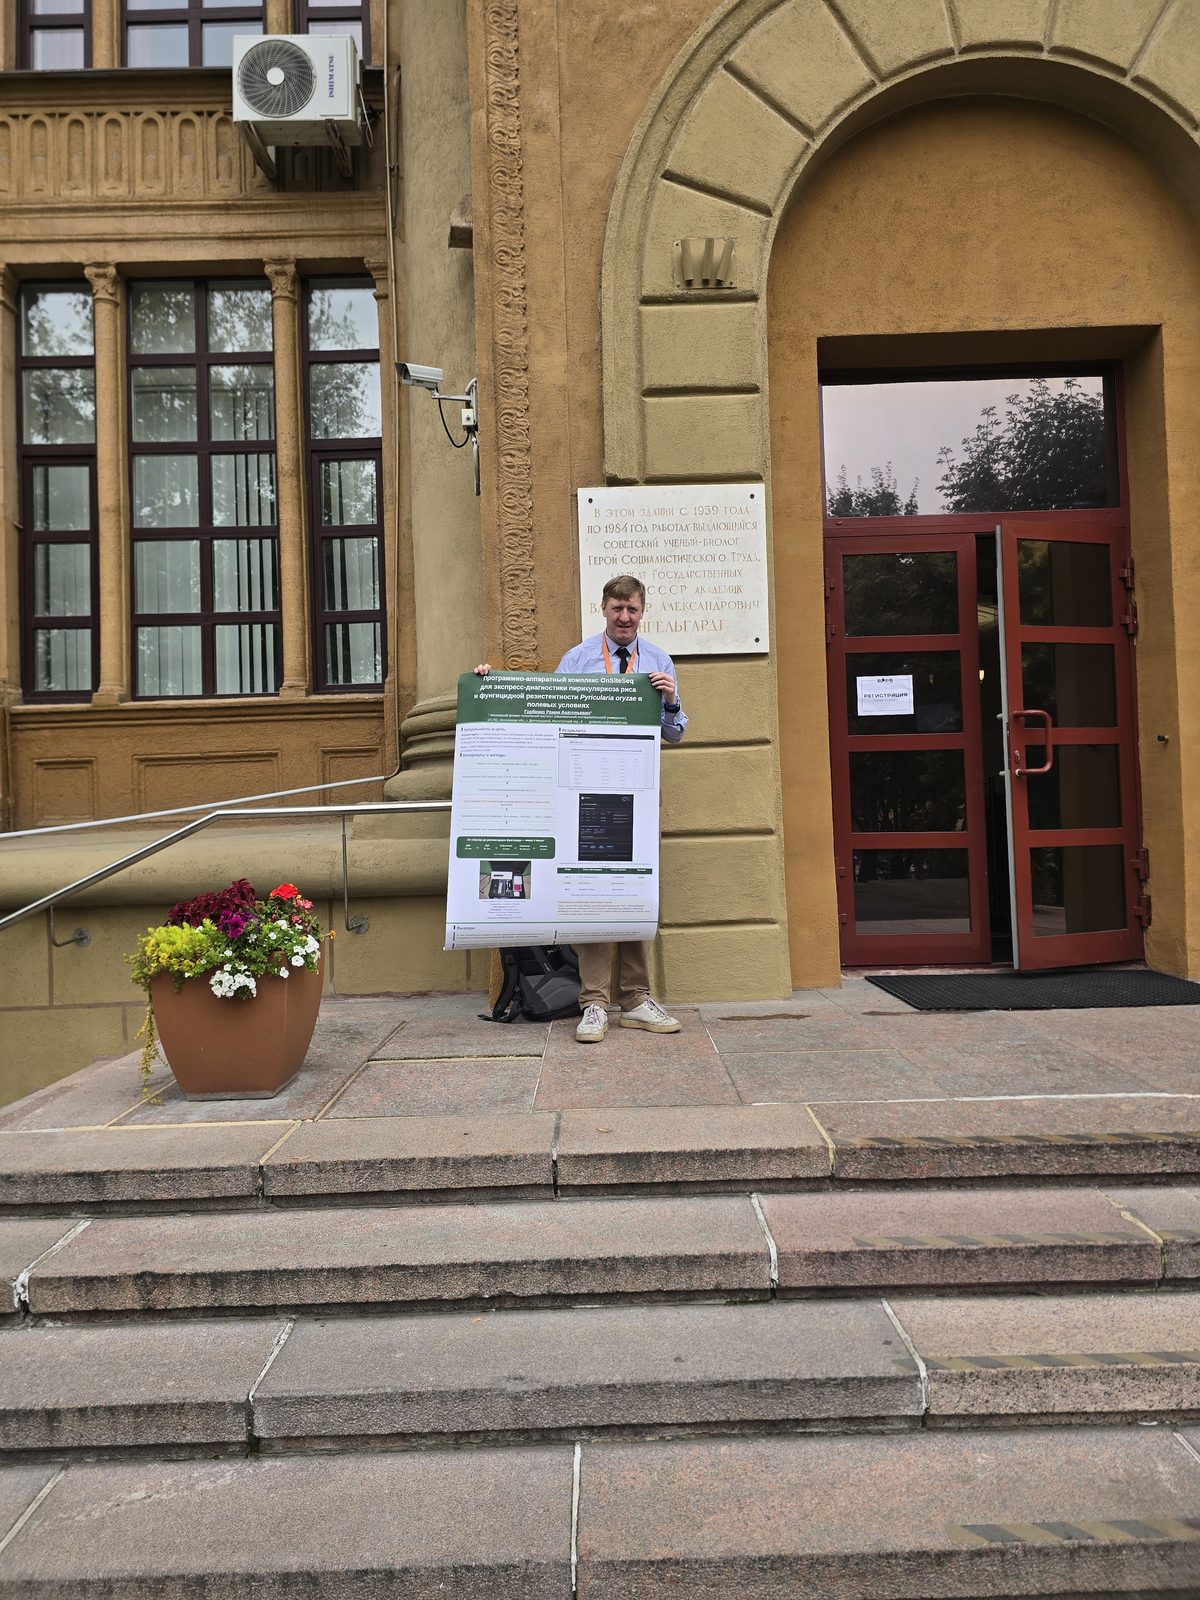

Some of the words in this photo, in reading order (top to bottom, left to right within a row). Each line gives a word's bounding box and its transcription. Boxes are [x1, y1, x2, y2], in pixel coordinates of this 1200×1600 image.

[594, 508, 601, 518] В
[605, 508, 635, 518] ЭТОМ
[641, 507, 674, 517] ЗДАНИИ
[679, 507, 687, 516] С
[694, 505, 719, 516] 1959
[724, 506, 750, 515] ГОДА
[587, 525, 601, 534] ПО
[605, 522, 628, 534] 1984
[630, 523, 648, 533] ГОД
[652, 523, 689, 533] РАБОТАЛ
[693, 520, 758, 532] ВЫДАЮЩИЙСЯ
[603, 537, 659, 549] СОВЕТСКИЙ
[663, 537, 741, 548] УЧЕНЫЙ-БИОЛОГ
[588, 554, 617, 565] ГЕРОЙ
[621, 553, 726, 565] СОЦИАЛИСТИЧЕСКОГО
[652, 569, 744, 579] ГОСУДАРСТВЕННЫХ
[647, 584, 687, 595] СССР
[694, 584, 743, 595] АКАДЕМИК
[661, 600, 760, 612] АЛЕКСАНДРОВИЧ
[639, 619, 725, 633] НГЕЛЬГАРДТ
[600, 677, 634, 685] OnSiteSeq
[493, 684, 568, 692] экспресс-диагностики
[479, 692, 525, 700] фунгицидной
[525, 693, 579, 701] резистентности
[579, 694, 614, 702] Pyricularia
